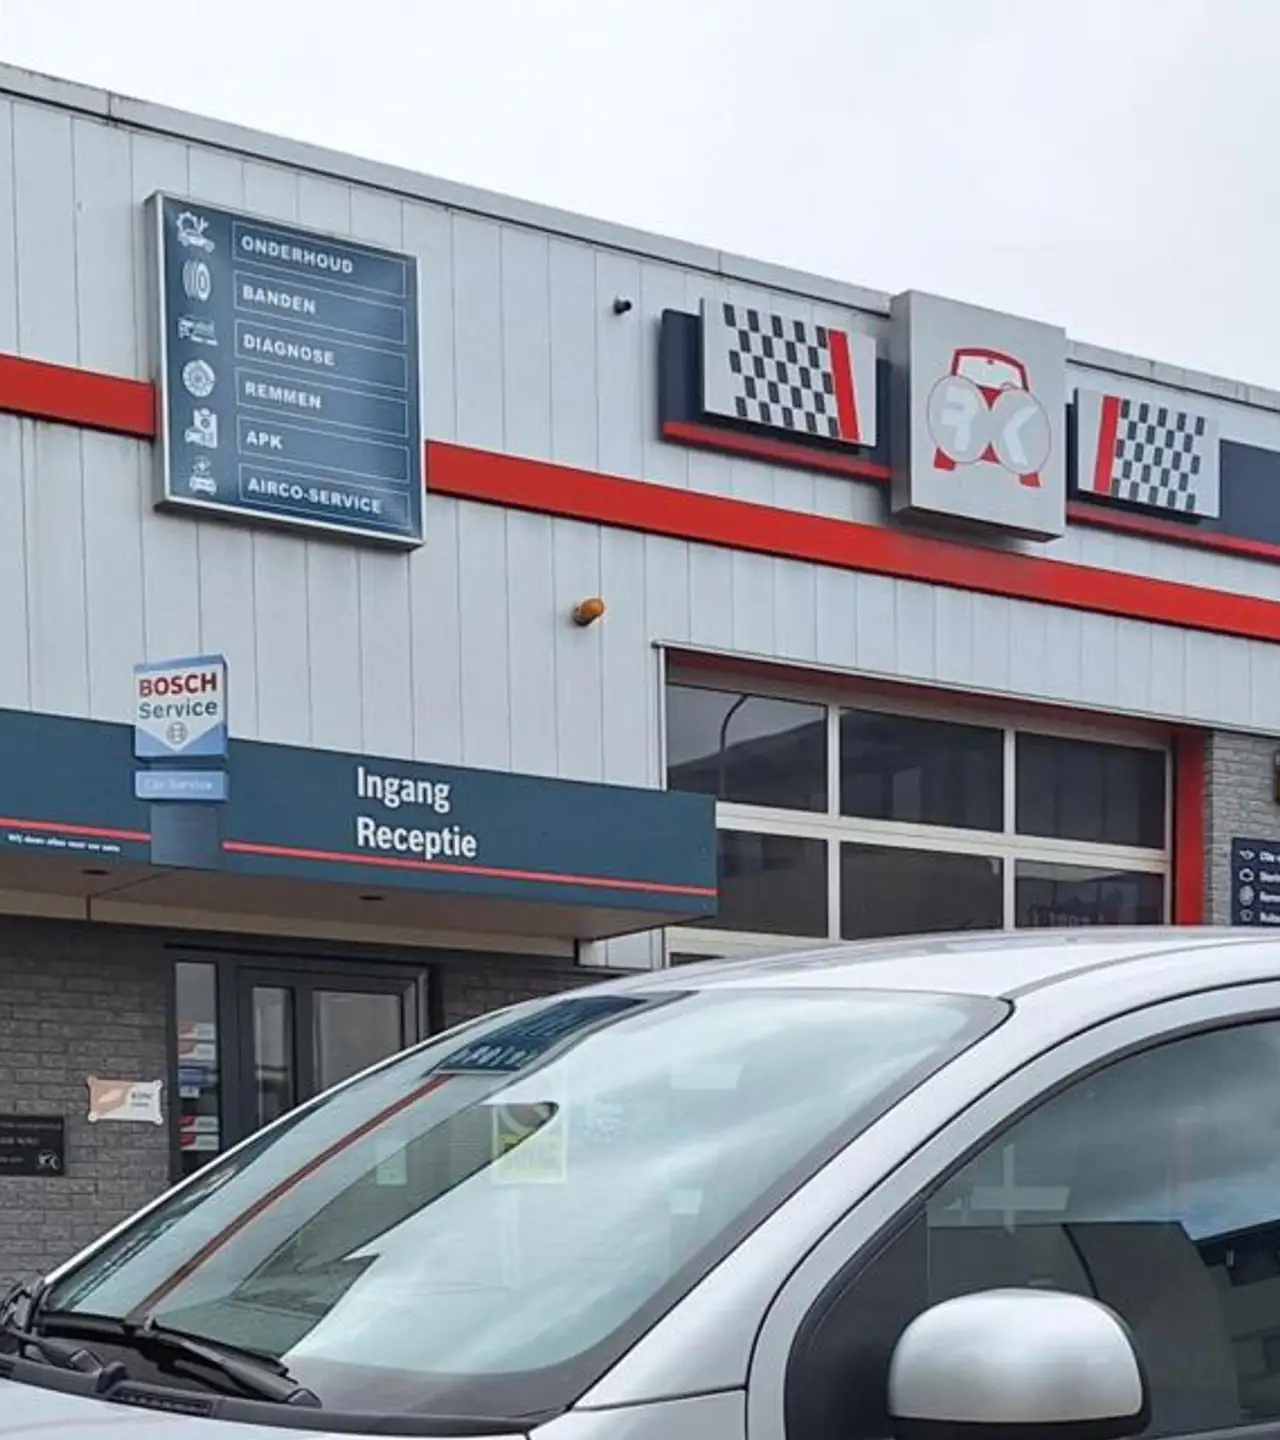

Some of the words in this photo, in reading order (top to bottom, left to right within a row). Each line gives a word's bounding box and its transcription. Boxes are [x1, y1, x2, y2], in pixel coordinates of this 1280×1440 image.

[241, 235, 353, 274] ONDERHOUD
[242, 285, 316, 315] BANDEN
[243, 333, 335, 366] DIAGNOSE
[245, 381, 322, 409] REMMEN
[246, 430, 283, 450] APK
[247, 477, 382, 514] AIRCO-SERVICE
[139, 672, 217, 697] BOSCH
[139, 699, 218, 719] Service
[357, 765, 451, 814] Ingang
[357, 816, 478, 861] Receptie
